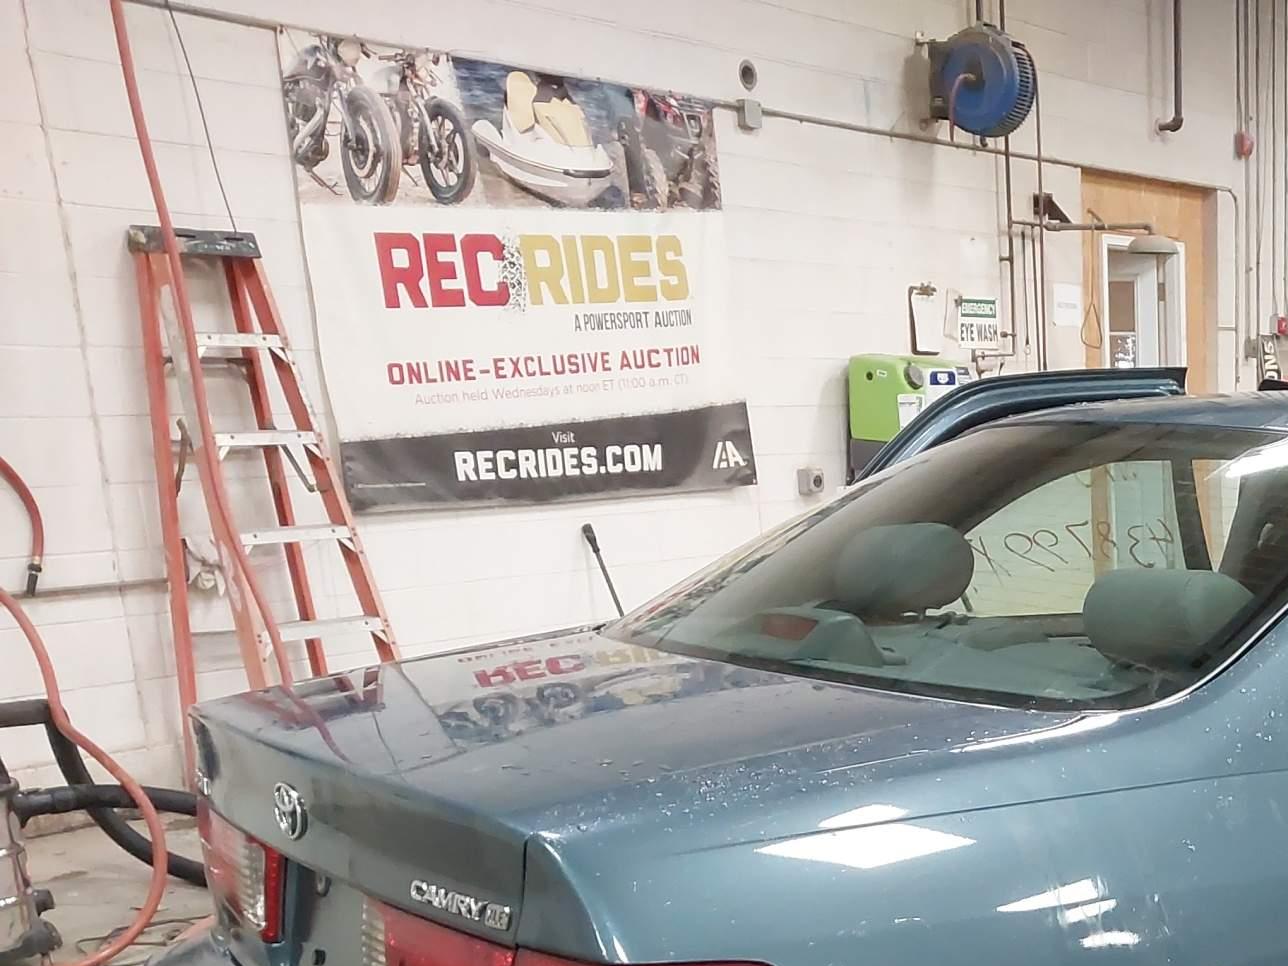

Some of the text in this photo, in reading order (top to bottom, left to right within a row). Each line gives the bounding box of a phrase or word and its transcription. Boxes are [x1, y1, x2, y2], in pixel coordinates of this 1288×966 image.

[374, 232, 689, 309] REC RIDES
[574, 309, 692, 331] A POWERSPORT AUCTION
[961, 302, 994, 315] EMERGENCY
[960, 323, 998, 342] EYE WASH
[387, 344, 700, 385] ONLINE-EXCLUSIVE AUCTION
[415, 392, 458, 406] Auction
[462, 389, 489, 402] held
[492, 385, 560, 400] Wednesdays
[563, 384, 574, 395] at
[577, 382, 600, 393] noon
[603, 378, 614, 391] ET
[551, 431, 576, 443] Visit
[454, 444, 662, 482] RECRIDES.COM
[410, 880, 488, 920] CAMRY
